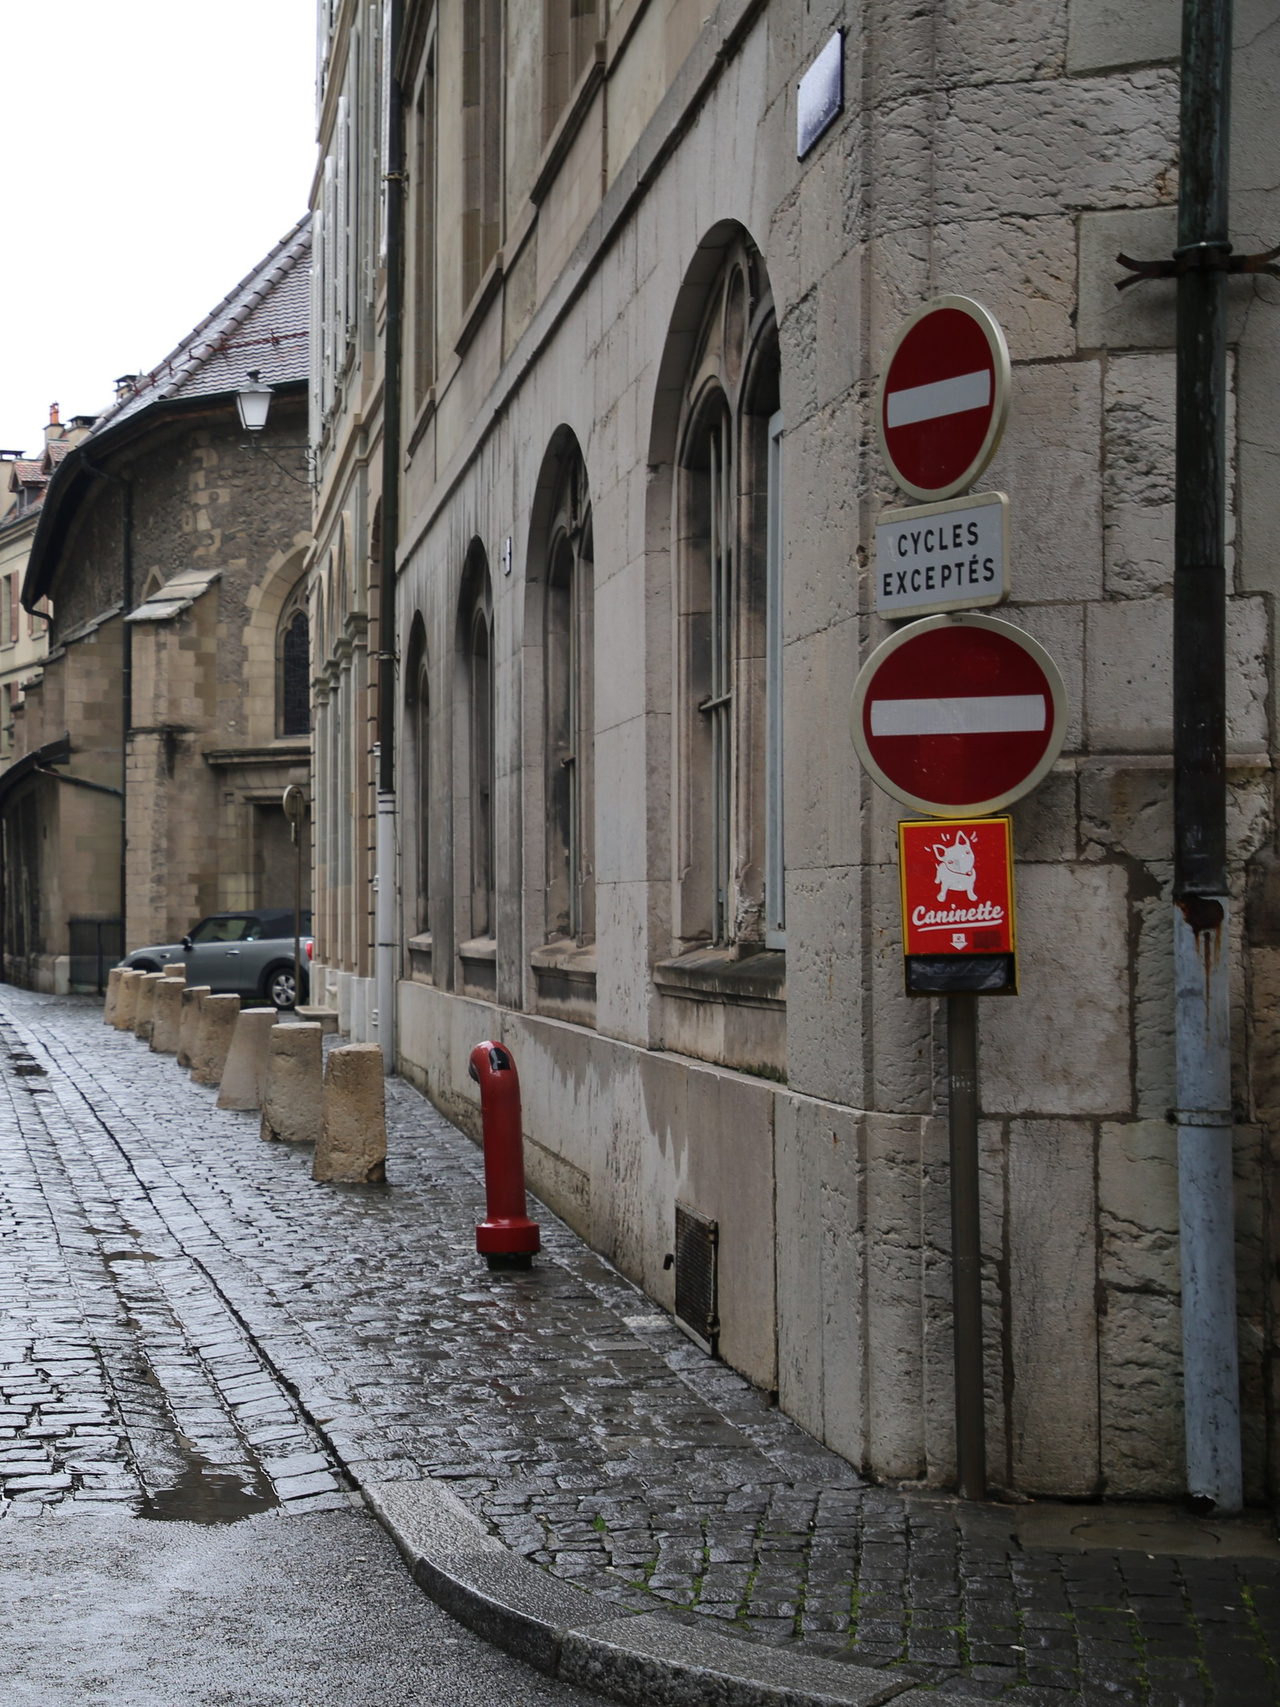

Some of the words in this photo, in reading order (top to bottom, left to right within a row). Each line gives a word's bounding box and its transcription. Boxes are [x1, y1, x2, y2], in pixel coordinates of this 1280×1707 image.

[898, 521, 979, 557] CYCLES
[883, 554, 995, 596] EXCEPTÉS
[912, 900, 1005, 926] Caninette
